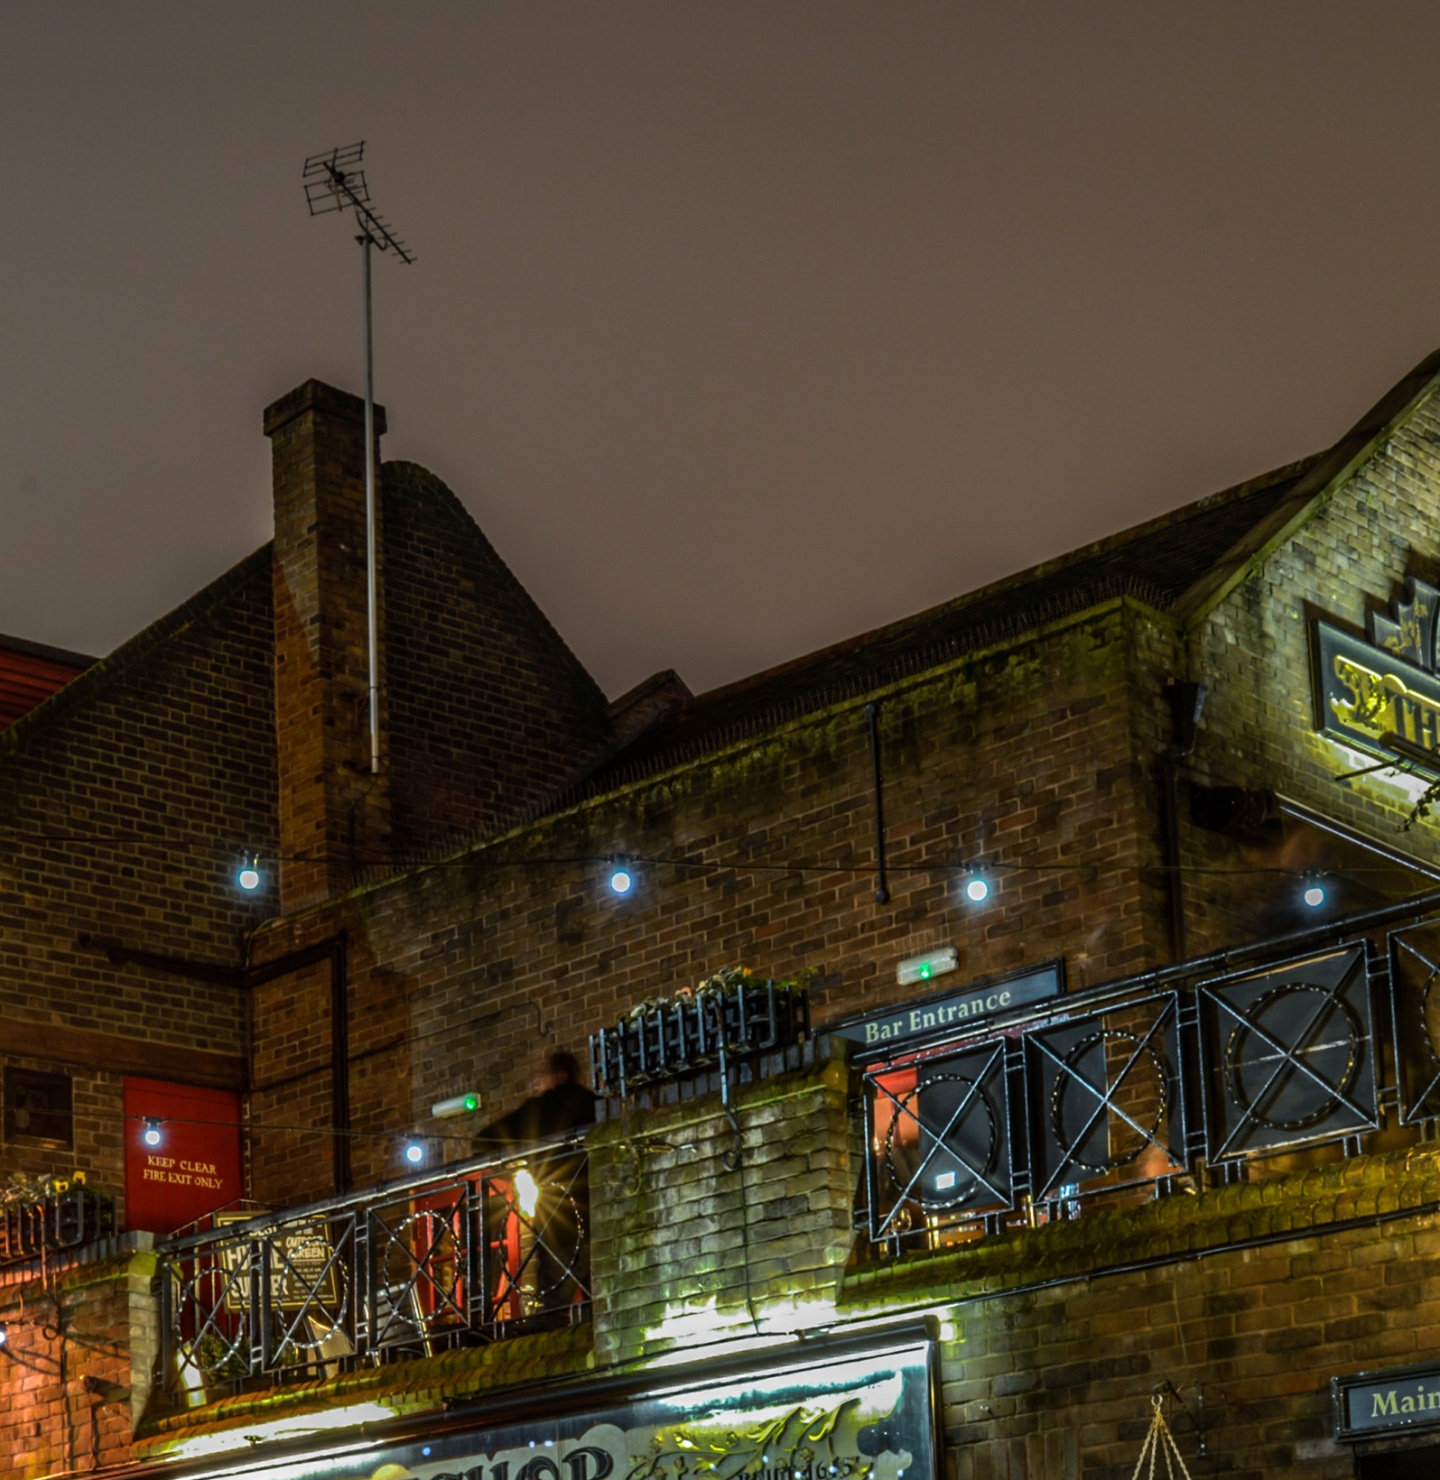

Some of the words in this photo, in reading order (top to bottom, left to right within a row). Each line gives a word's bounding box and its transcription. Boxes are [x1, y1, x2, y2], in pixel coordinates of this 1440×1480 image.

[865, 1021, 902, 1044] Bar
[909, 991, 1011, 1033] Entrance
[147, 1155, 176, 1169] KEEP
[180, 1160, 217, 1175] CLEAR
[143, 1169, 166, 1182] FIRE
[168, 1172, 192, 1185] EXIT
[194, 1177, 223, 1189] ONLY
[1371, 1385, 1440, 1418] Main
